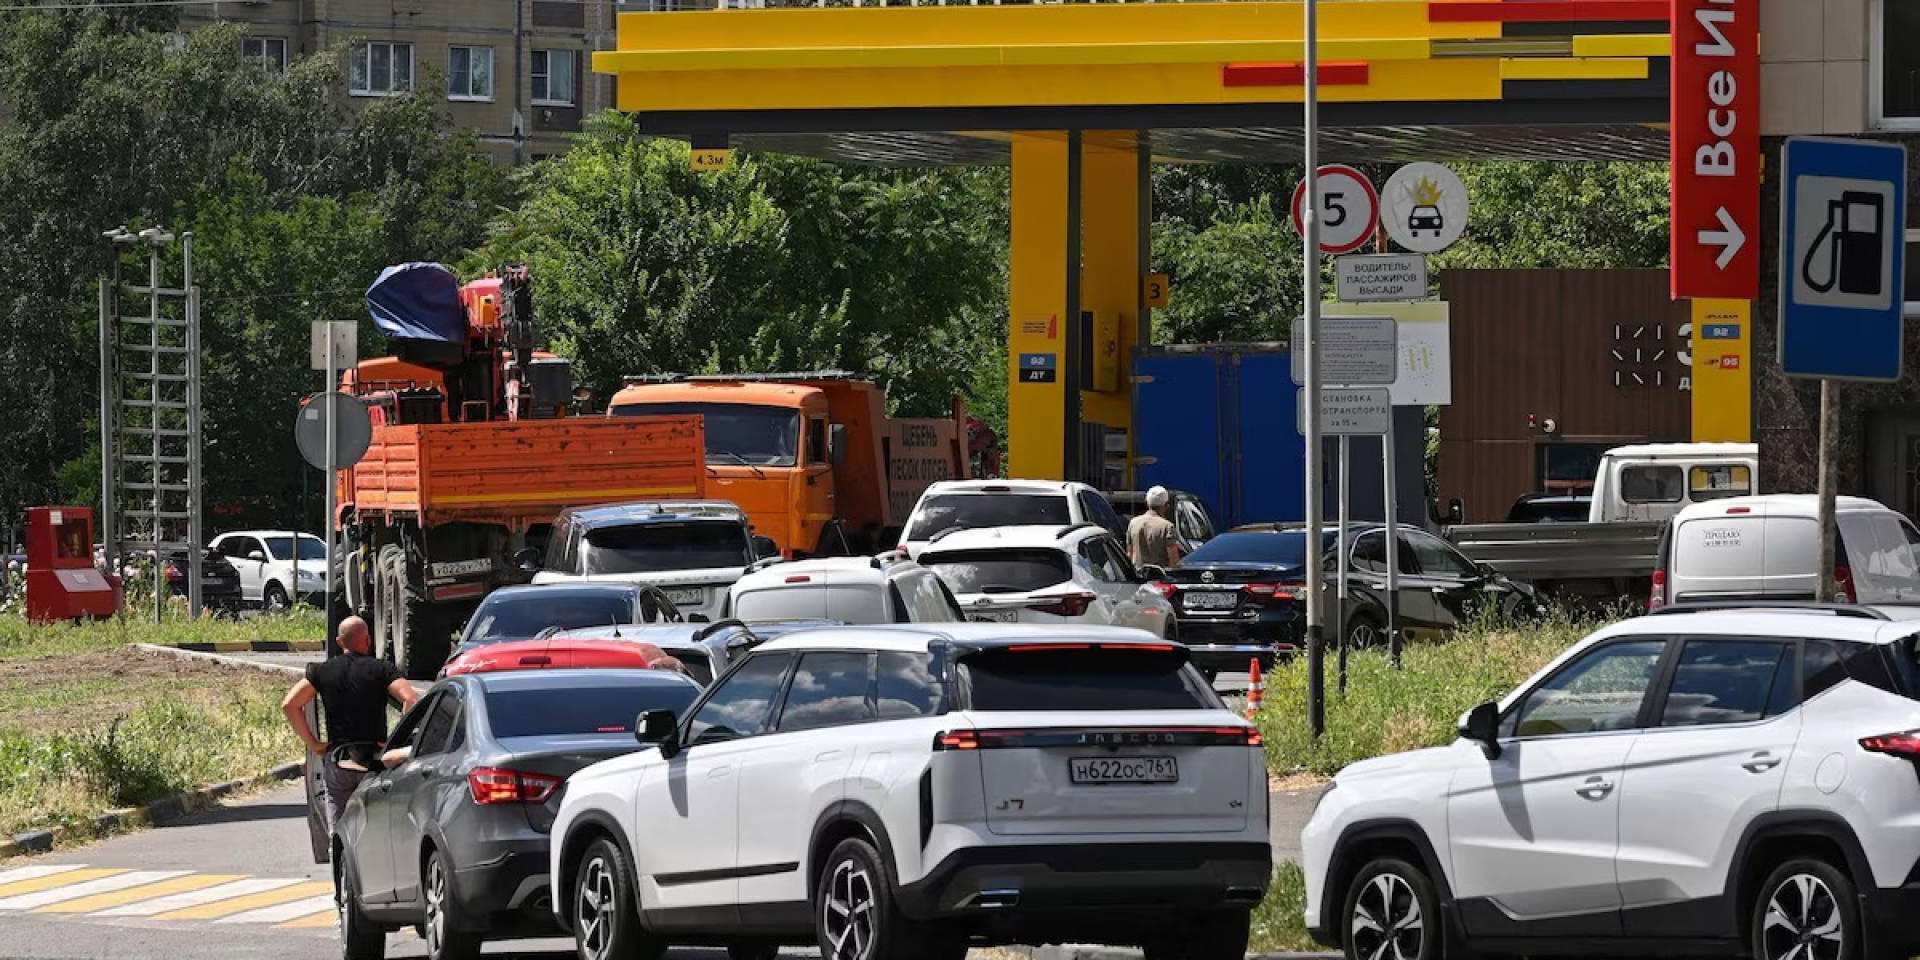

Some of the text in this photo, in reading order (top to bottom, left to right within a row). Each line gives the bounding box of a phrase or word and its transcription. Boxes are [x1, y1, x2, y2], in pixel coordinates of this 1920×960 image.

[1695, 70, 1737, 177] Все
[1324, 192, 1347, 227] 5
[1354, 261, 1412, 274] ВОДИТЕЛЬ!
[1346, 273, 1417, 284] ПАССАЖИРОВ
[1149, 283, 1161, 299] 3
[1359, 285, 1404, 296] ВЫСАДИ
[1713, 327, 1729, 336] 92
[1030, 356, 1046, 366] 92
[1722, 357, 1738, 366] 95
[1028, 370, 1046, 380] ДТ
[1322, 394, 1372, 403] СТАНОВКА
[902, 424, 937, 446] ЩЕБЕНЬ
[891, 458, 919, 481] ПЕСОК
[1076, 733, 1175, 743] JAECOO
[1076, 759, 1174, 779] Н622ОС 761
[996, 799, 1025, 810] J7
